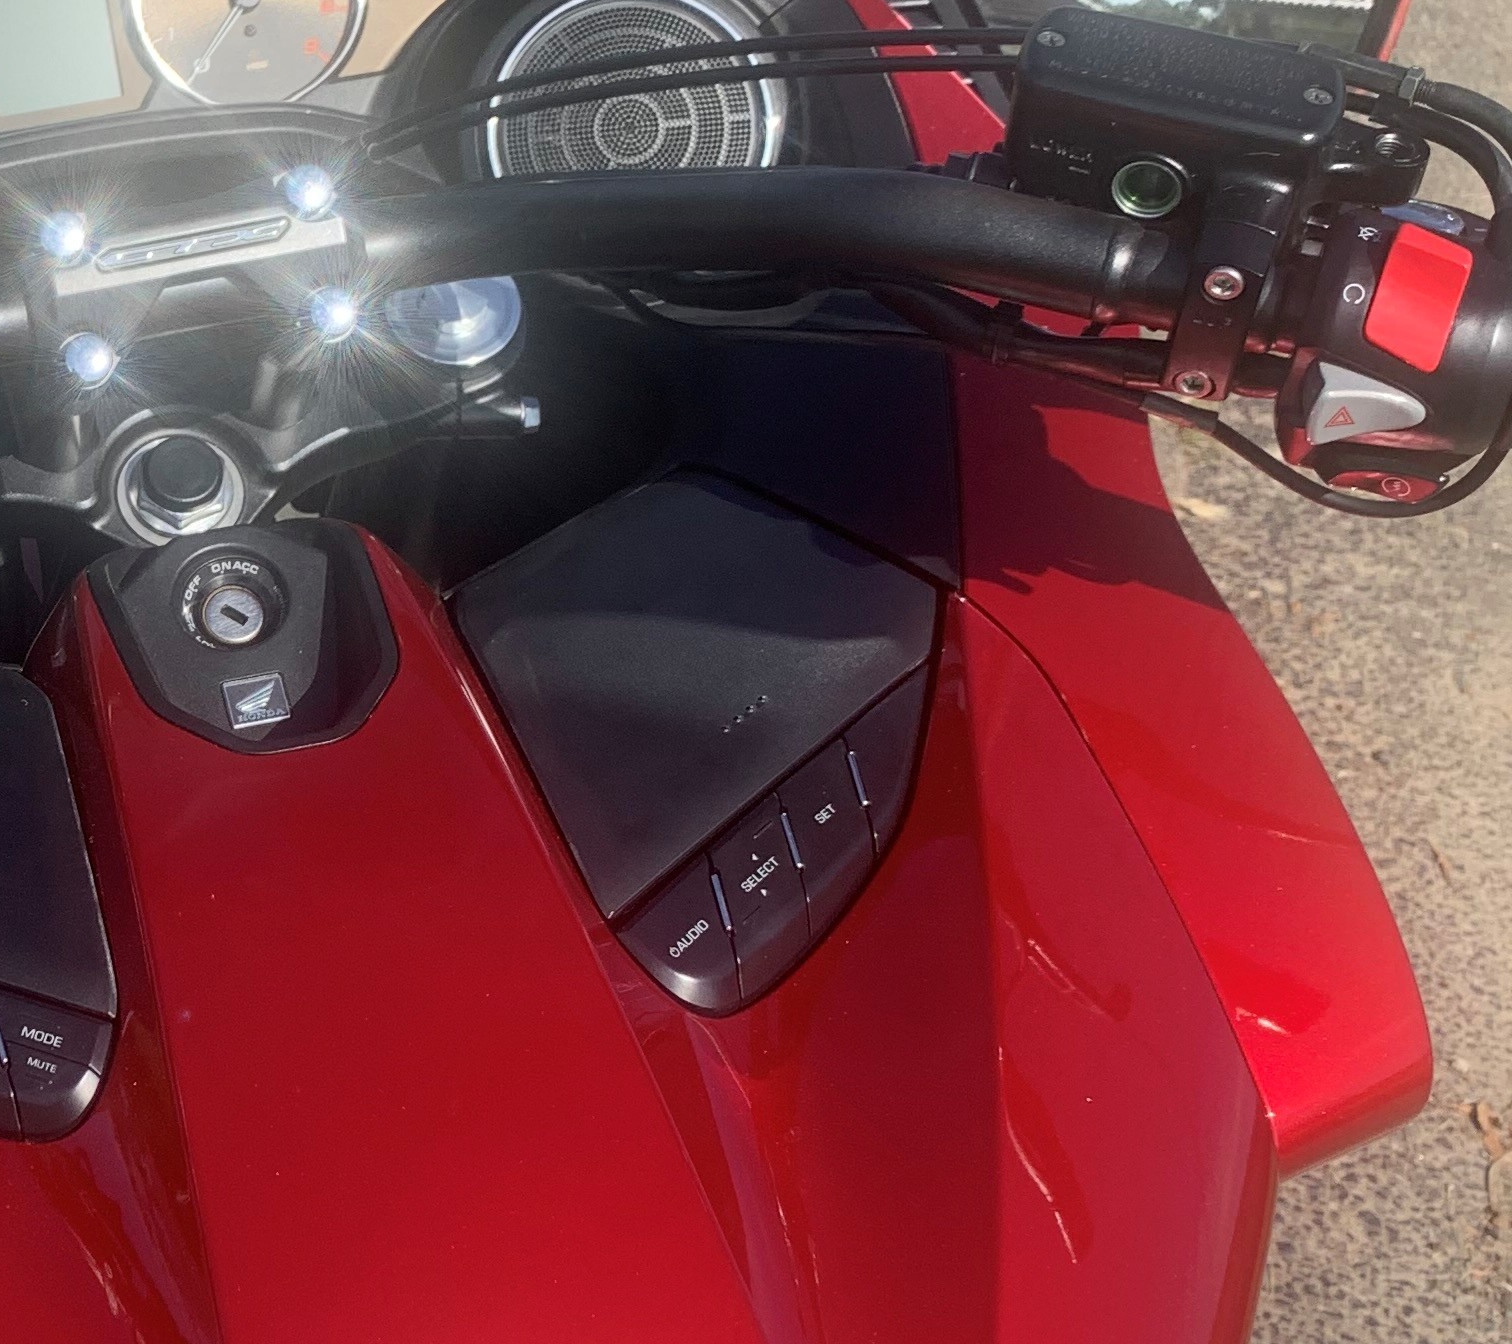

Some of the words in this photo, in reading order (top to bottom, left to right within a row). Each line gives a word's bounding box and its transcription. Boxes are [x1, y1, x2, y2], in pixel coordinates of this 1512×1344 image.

[211, 561, 232, 573] ON
[233, 561, 260, 575] ACC
[184, 575, 202, 601] OFF
[238, 708, 286, 723] HONDA
[814, 803, 837, 826] SET
[740, 855, 780, 894] SELECT
[676, 919, 710, 954] AUDIO
[20, 1025, 64, 1049] MODE
[26, 1056, 58, 1075] MUTE
